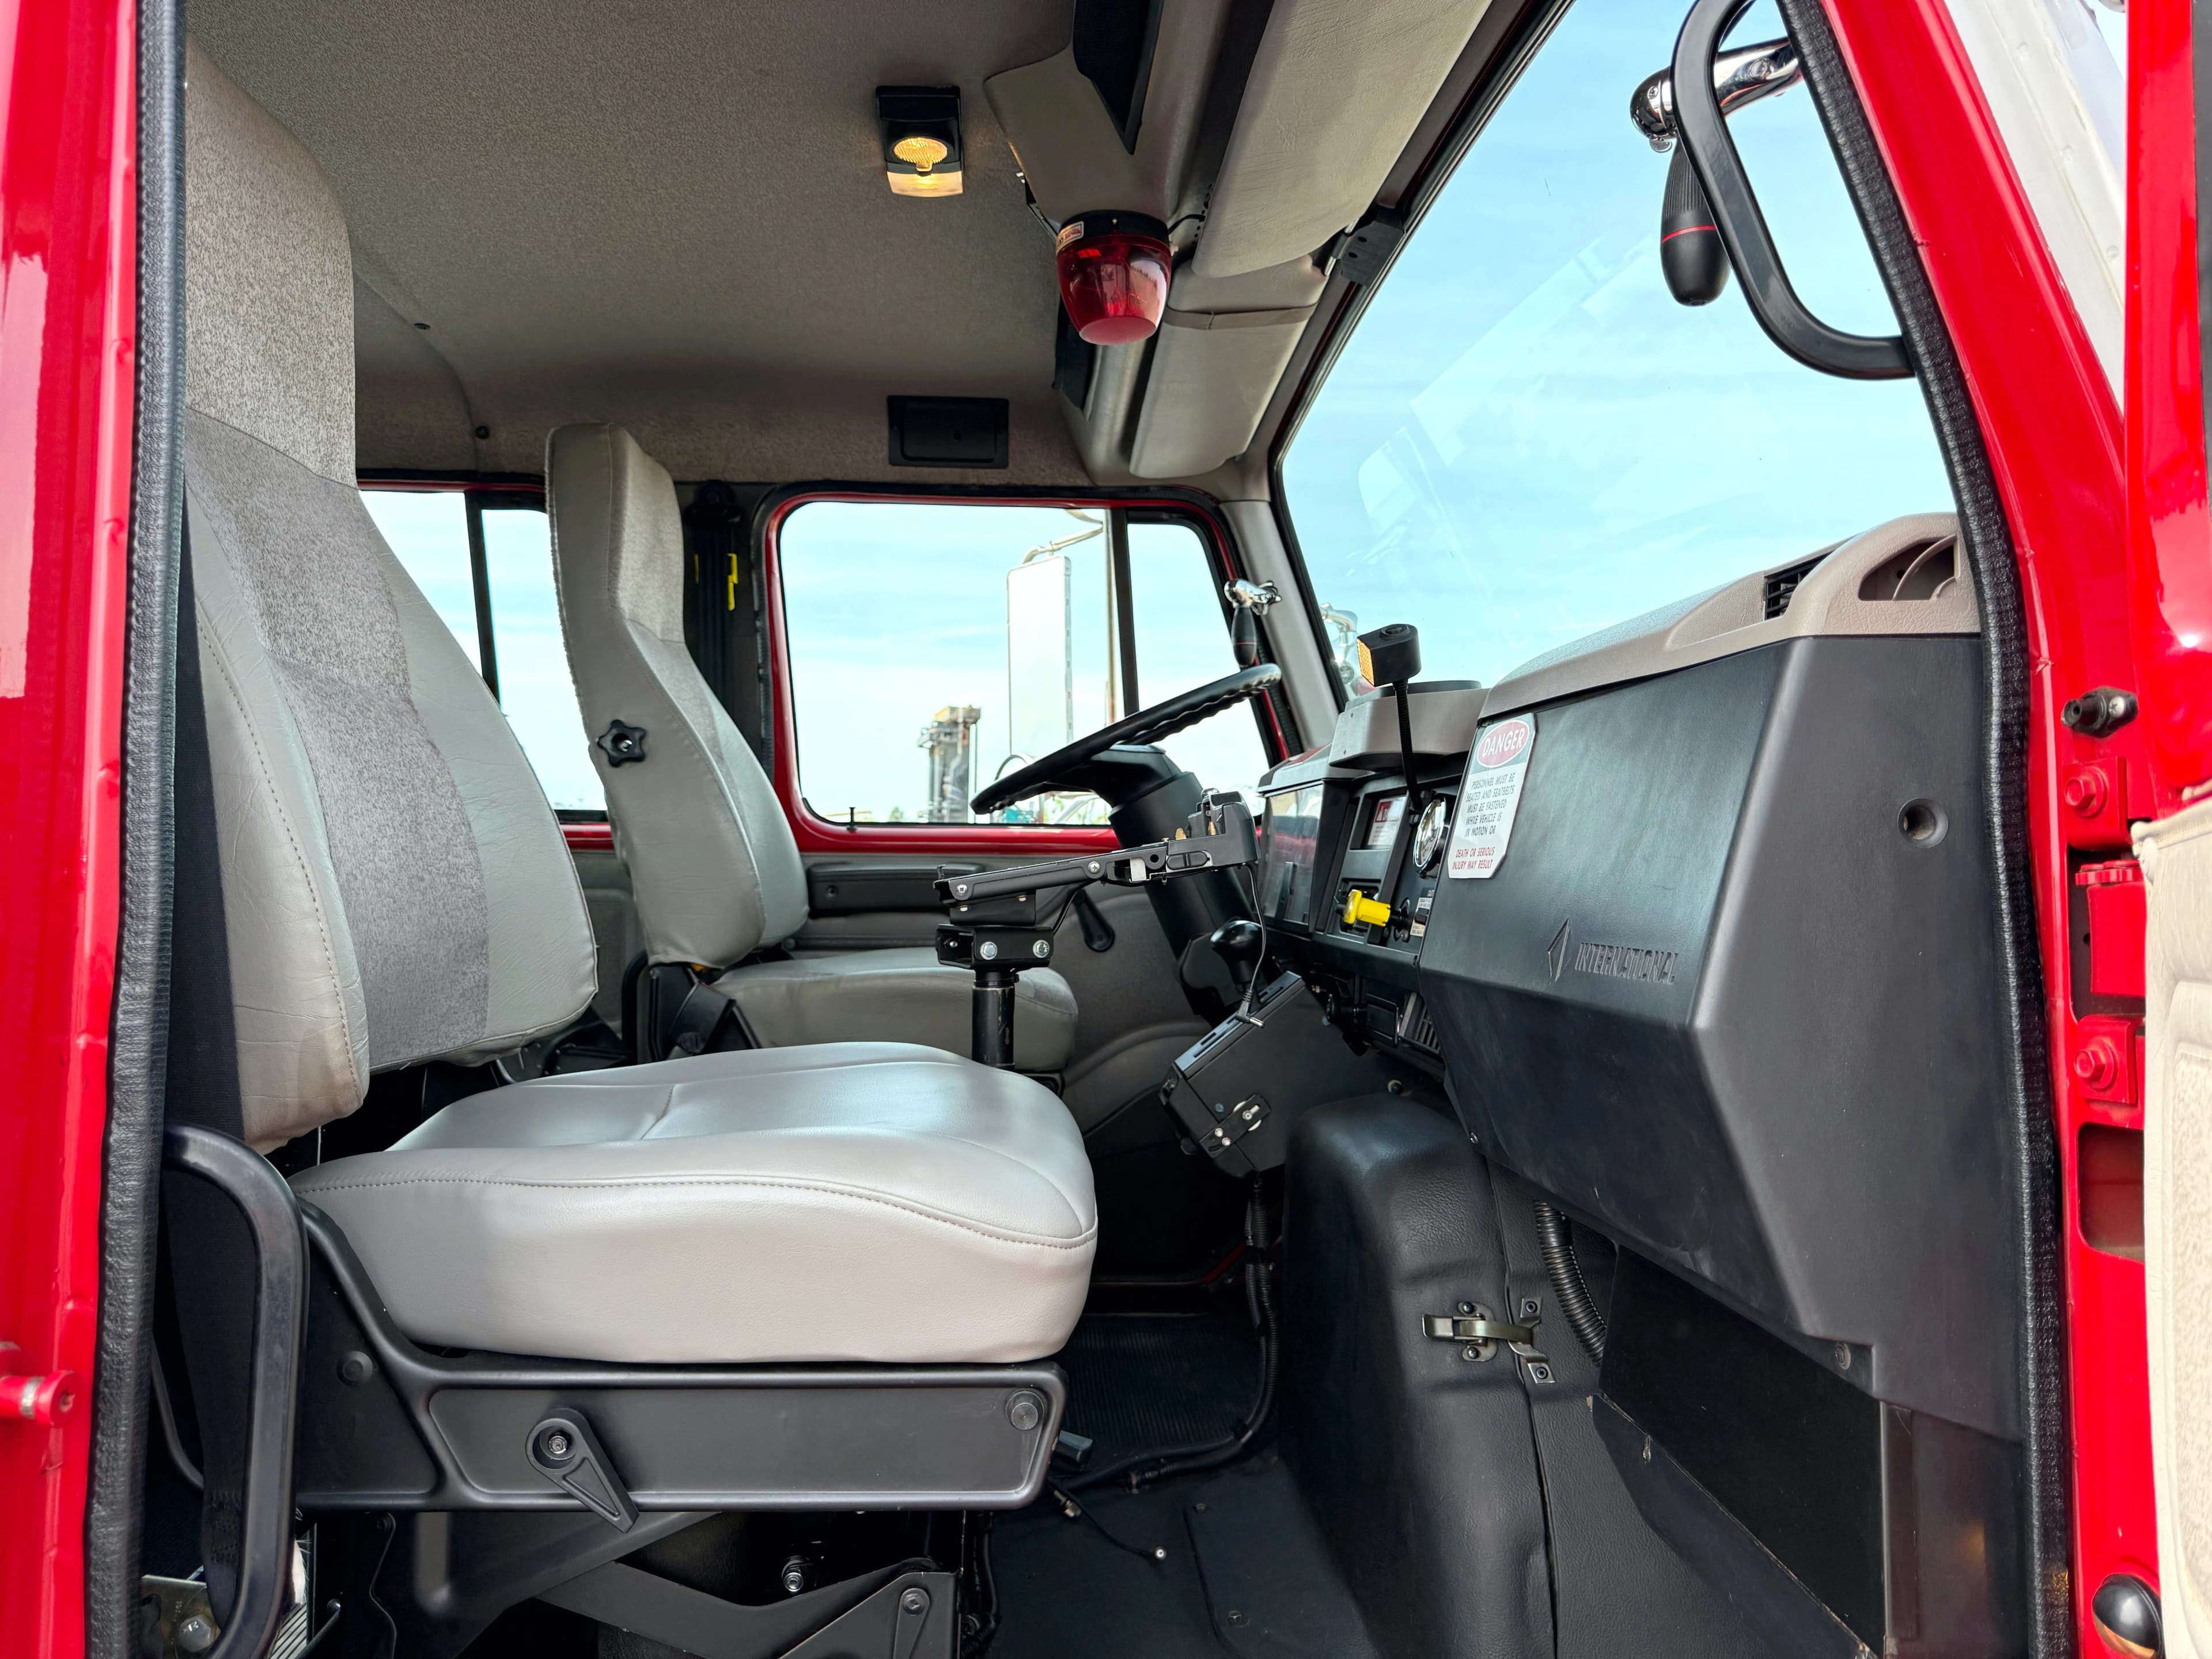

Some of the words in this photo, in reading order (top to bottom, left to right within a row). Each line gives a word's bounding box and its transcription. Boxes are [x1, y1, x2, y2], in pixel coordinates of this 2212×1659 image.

[1482, 728, 1525, 757] DANGER
[1472, 778, 1494, 789] PERSONNEL
[1495, 775, 1508, 785] MUST
[1509, 772, 1516, 782] BE
[1466, 791, 1481, 802] SEATED
[1482, 790, 1491, 800] AND
[1493, 785, 1515, 797] SEATBELTS
[1467, 804, 1478, 813] MUST
[1479, 802, 1485, 812] BE
[1486, 799, 1506, 810] FASTENED
[1466, 815, 1478, 825] WHILE
[1479, 813, 1497, 824] VEHICLE
[1497, 812, 1502, 821] IS
[1465, 828, 1470, 837] IN
[1472, 826, 1487, 836] MOTION
[1489, 825, 1496, 835] OR
[1456, 849, 1469, 858] DEATH
[1470, 847, 1476, 857] OR
[1477, 846, 1495, 857] SERIOUS
[1452, 861, 1466, 870] INJURY
[1467, 860, 1477, 869] MAY
[1478, 859, 1493, 869] RESULT
[1575, 942, 1678, 985] INTERNATIONAL
